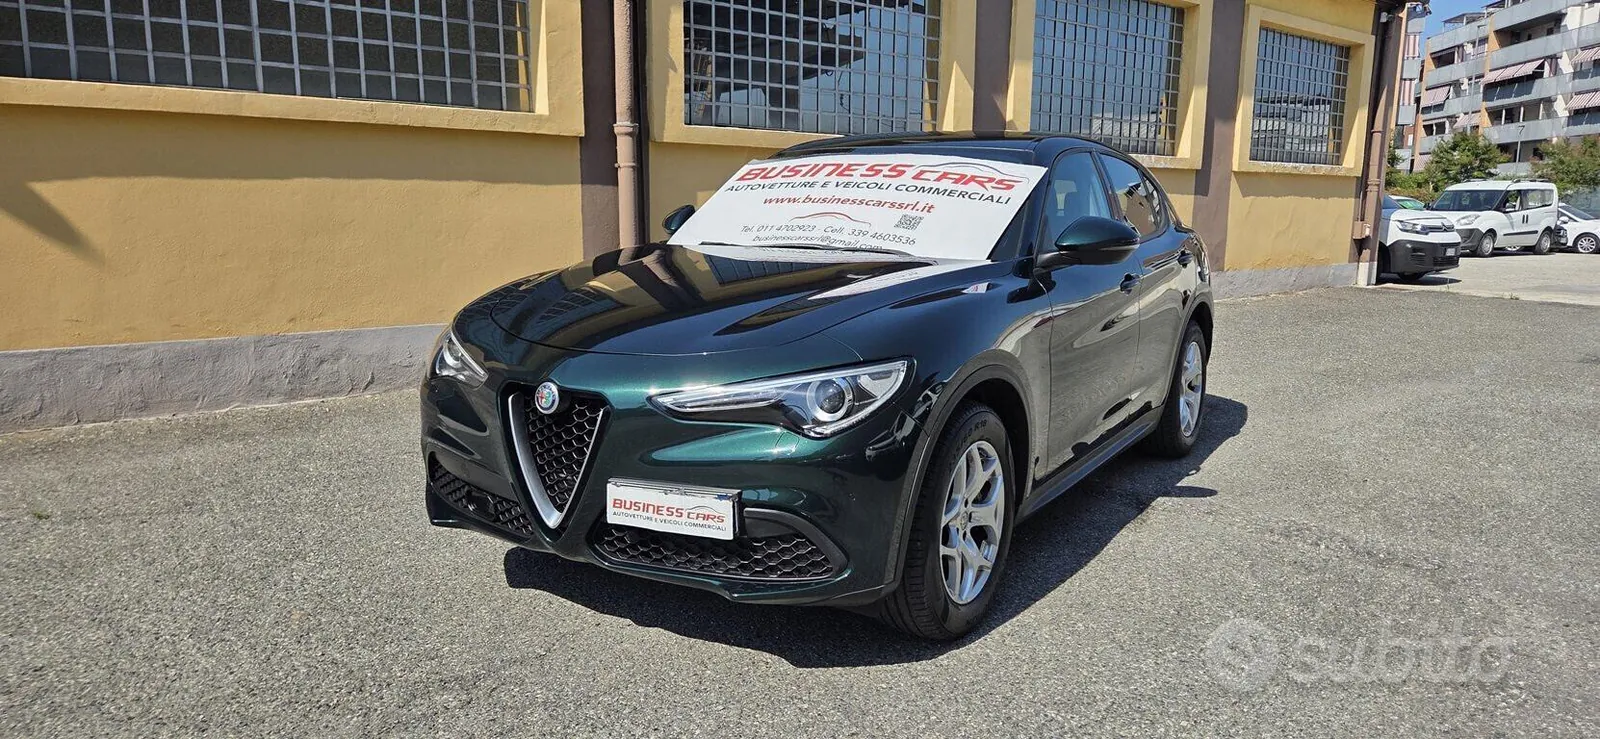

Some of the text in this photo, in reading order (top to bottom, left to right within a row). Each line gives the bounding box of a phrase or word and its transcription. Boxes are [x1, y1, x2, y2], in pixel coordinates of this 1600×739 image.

[736, 163, 1023, 191] BUSINESS CARS
[724, 181, 820, 192] AUTOVETTURE
[835, 181, 892, 190] VEICOLI
[891, 184, 1012, 205] COMMERCIALI
[762, 194, 935, 214] www.businesscarssrl.it
[740, 225, 754, 233] Tel.
[823, 225, 845, 235] Cell.
[848, 228, 869, 237] 339
[869, 231, 916, 246] 4603536
[612, 498, 726, 524] BUSINESS CARS
[612, 511, 653, 522] AUTOVETTURE
[659, 517, 683, 526] VEICOLI
[684, 521, 727, 531] COMMERCIALI
